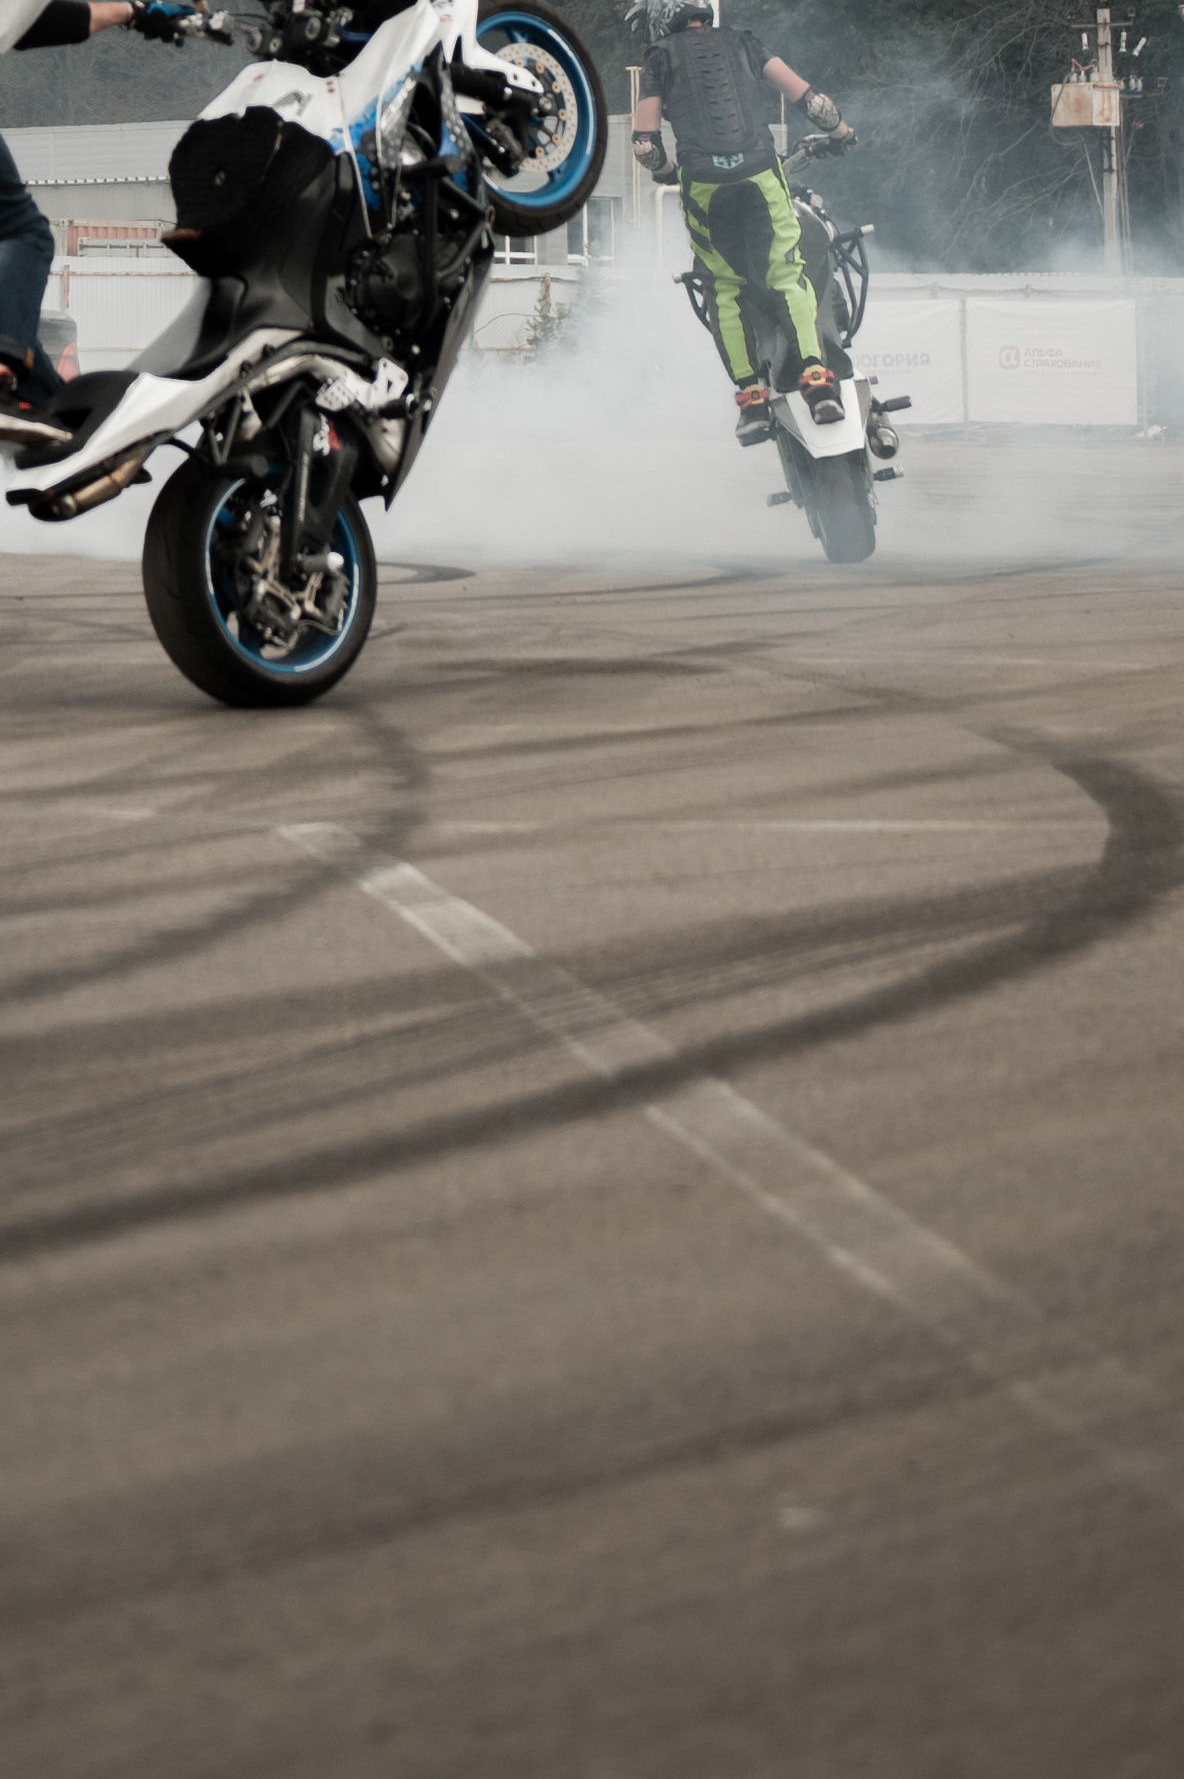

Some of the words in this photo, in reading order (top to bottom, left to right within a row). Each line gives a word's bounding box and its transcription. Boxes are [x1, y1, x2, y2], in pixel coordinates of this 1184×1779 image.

[1024, 348, 1063, 357] АЛЬФА
[857, 353, 930, 368] ЮГОРИЯ
[1024, 358, 1102, 369] СТРАХОВАНИЕ
